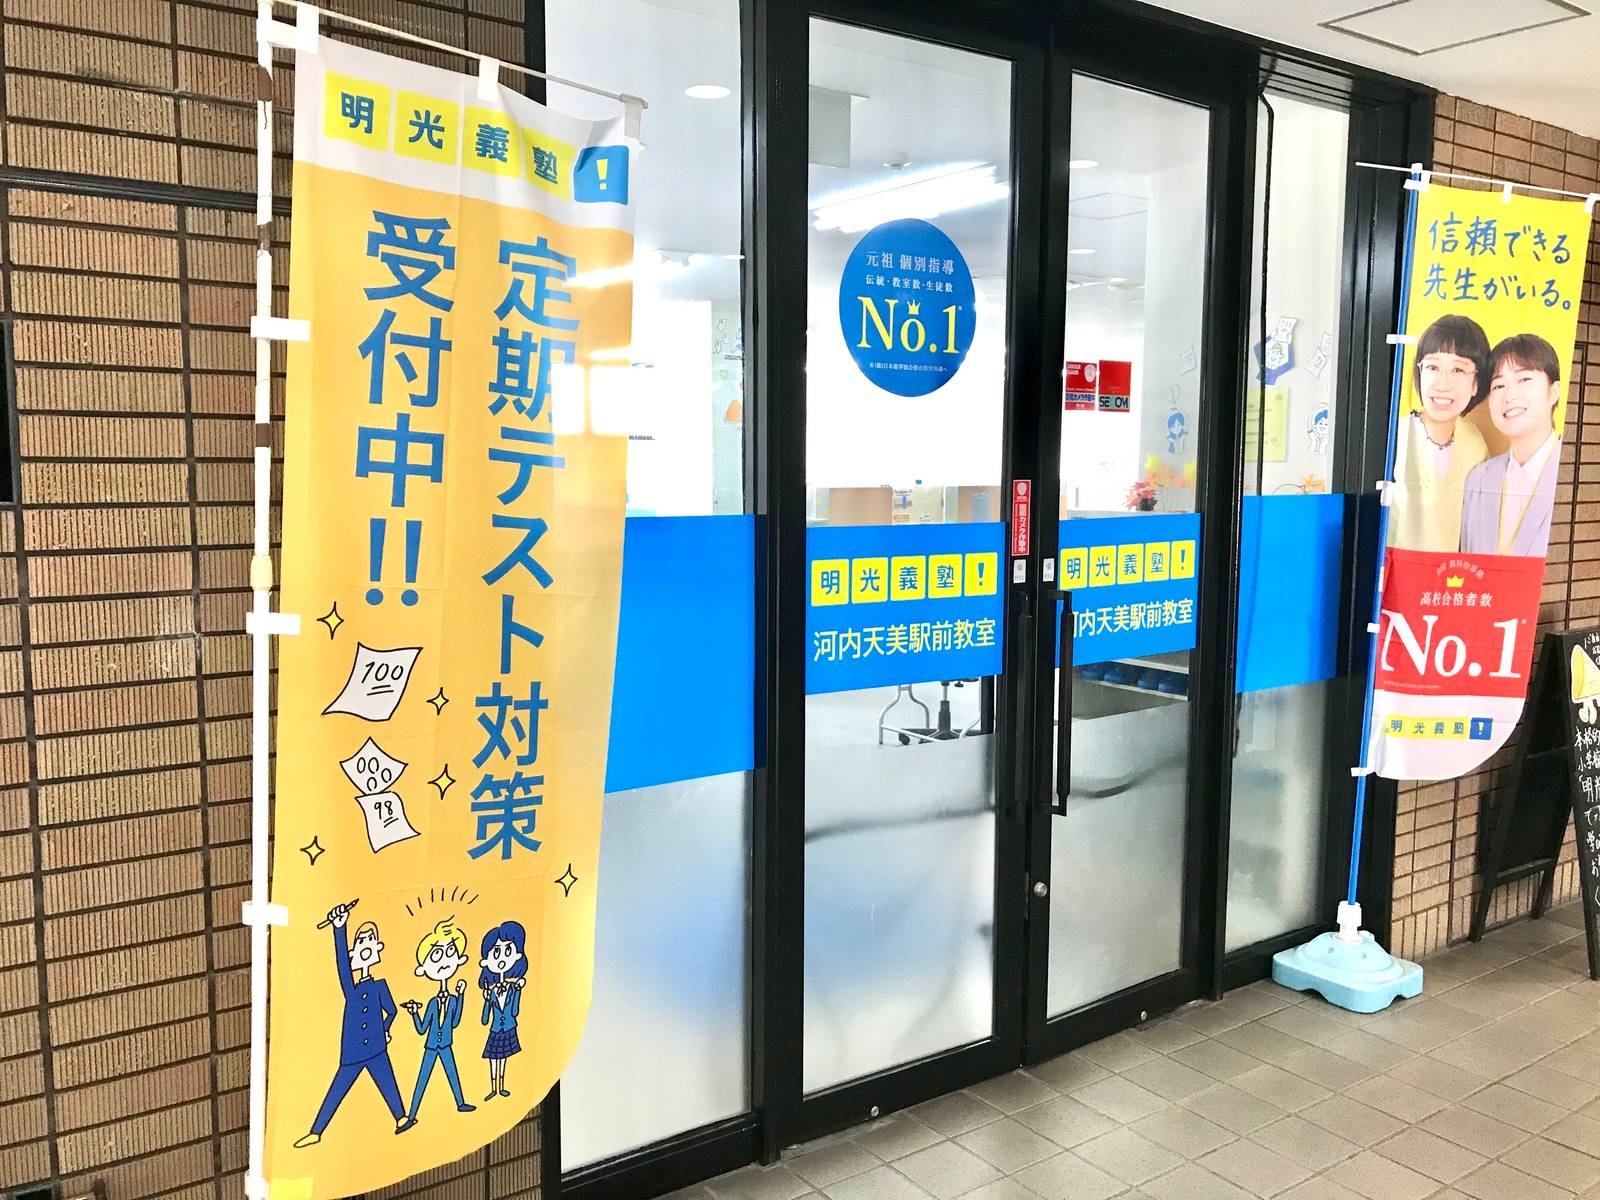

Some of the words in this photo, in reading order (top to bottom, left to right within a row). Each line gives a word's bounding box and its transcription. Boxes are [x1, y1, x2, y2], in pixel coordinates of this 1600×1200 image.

[341, 92, 609, 190] 明光義塾!
[1429, 212, 1570, 264] 信頼できる
[866, 251, 893, 269] 元祖
[900, 254, 954, 275] 個別指導
[1423, 263, 1571, 310] 先生がいる。
[857, 296, 960, 354] No.1
[355, 210, 456, 607] 受付中!!
[1099, 396, 1128, 408] SEOM
[467, 236, 580, 861] 定期テスト対策
[1067, 549, 1185, 579] 明光義塾!
[821, 561, 985, 594] 明光義塾!
[1420, 591, 1493, 608] 高校合格者数
[814, 618, 996, 662] 河内天美駅前教室
[1380, 608, 1521, 678] No.1
[361, 662, 404, 684] 100
[374, 800, 394, 820] 98
